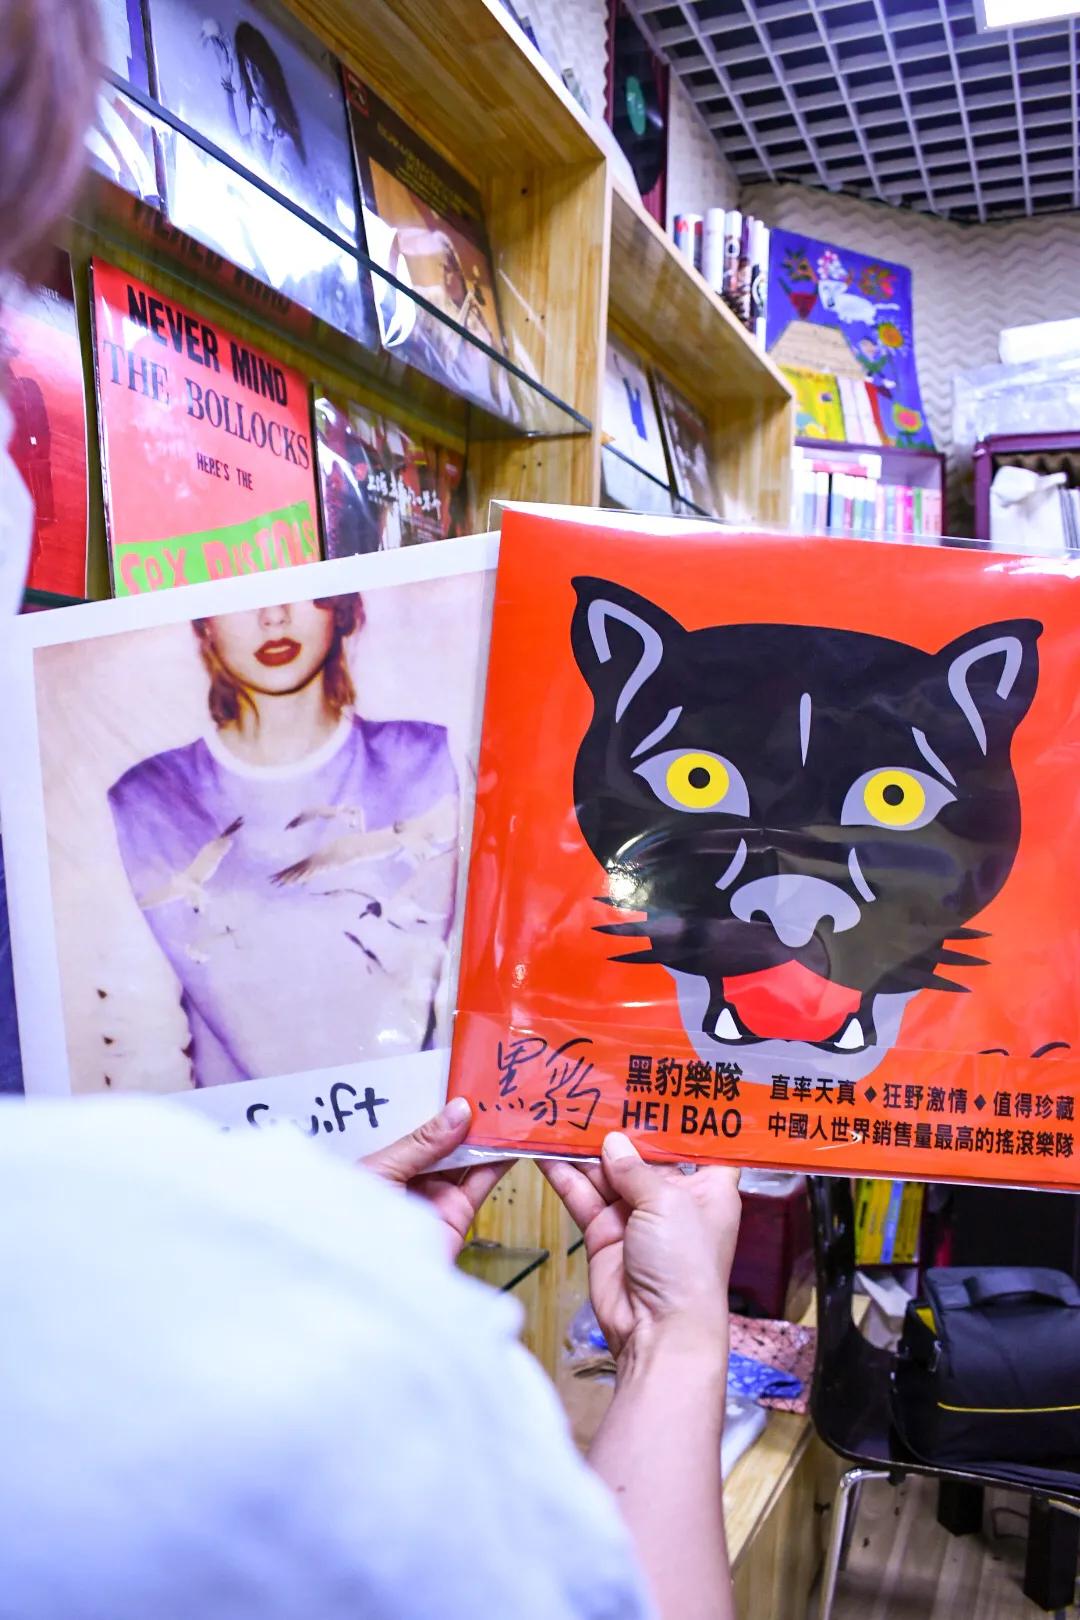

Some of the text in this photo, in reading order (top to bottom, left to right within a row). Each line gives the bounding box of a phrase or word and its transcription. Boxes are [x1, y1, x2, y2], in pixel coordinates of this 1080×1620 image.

[126, 283, 220, 374] NEVER
[229, 341, 288, 407] MIND
[103, 340, 310, 470] THE BOLLOCKS
[196, 452, 254, 491] HERE'S THE
[625, 1054, 744, 1102] 黑豹樂隊
[769, 1074, 1075, 1122] 直率天真 狂野激情 值得珍藏
[621, 1099, 742, 1138] HEI BAO
[767, 1111, 1075, 1158] 中國人世界銷售量最高的搖滾樂隊
